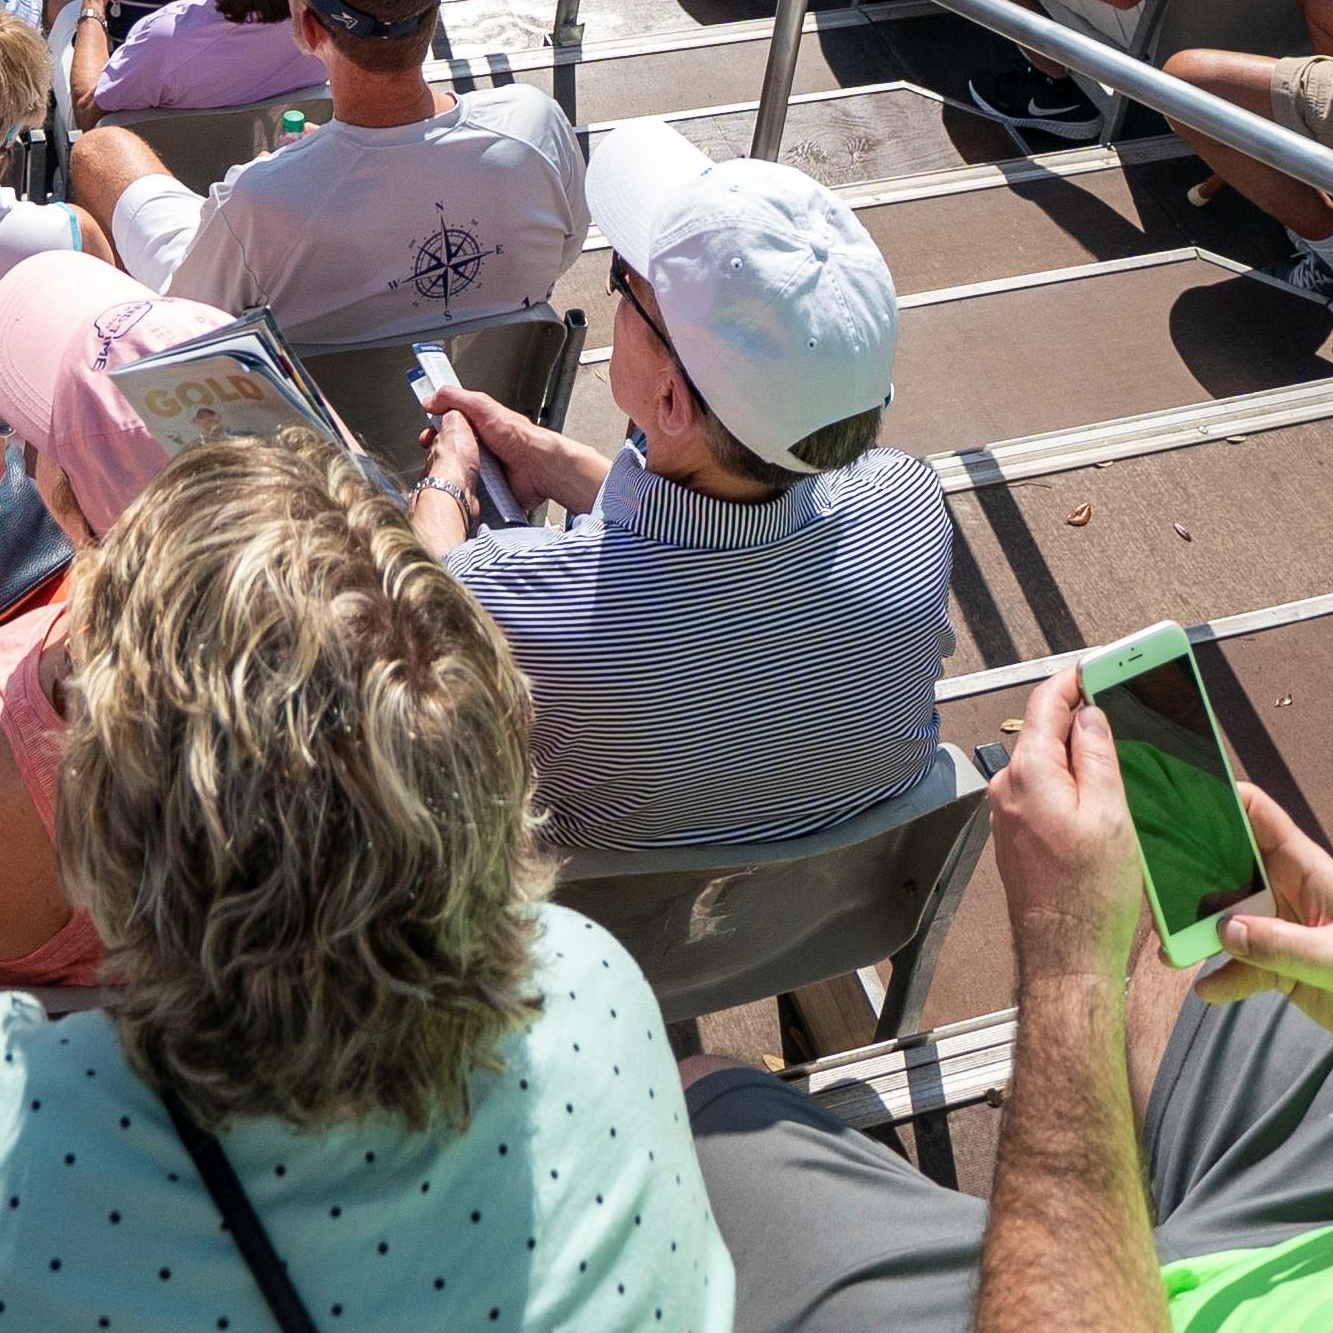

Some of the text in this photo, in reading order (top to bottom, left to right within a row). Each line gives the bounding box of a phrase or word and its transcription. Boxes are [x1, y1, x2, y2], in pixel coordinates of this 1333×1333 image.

[435, 200, 444, 214] N
[495, 244, 504, 255] E
[387, 279, 400, 291] W
[444, 310, 453, 321] S
[144, 375, 265, 419] GOLD
